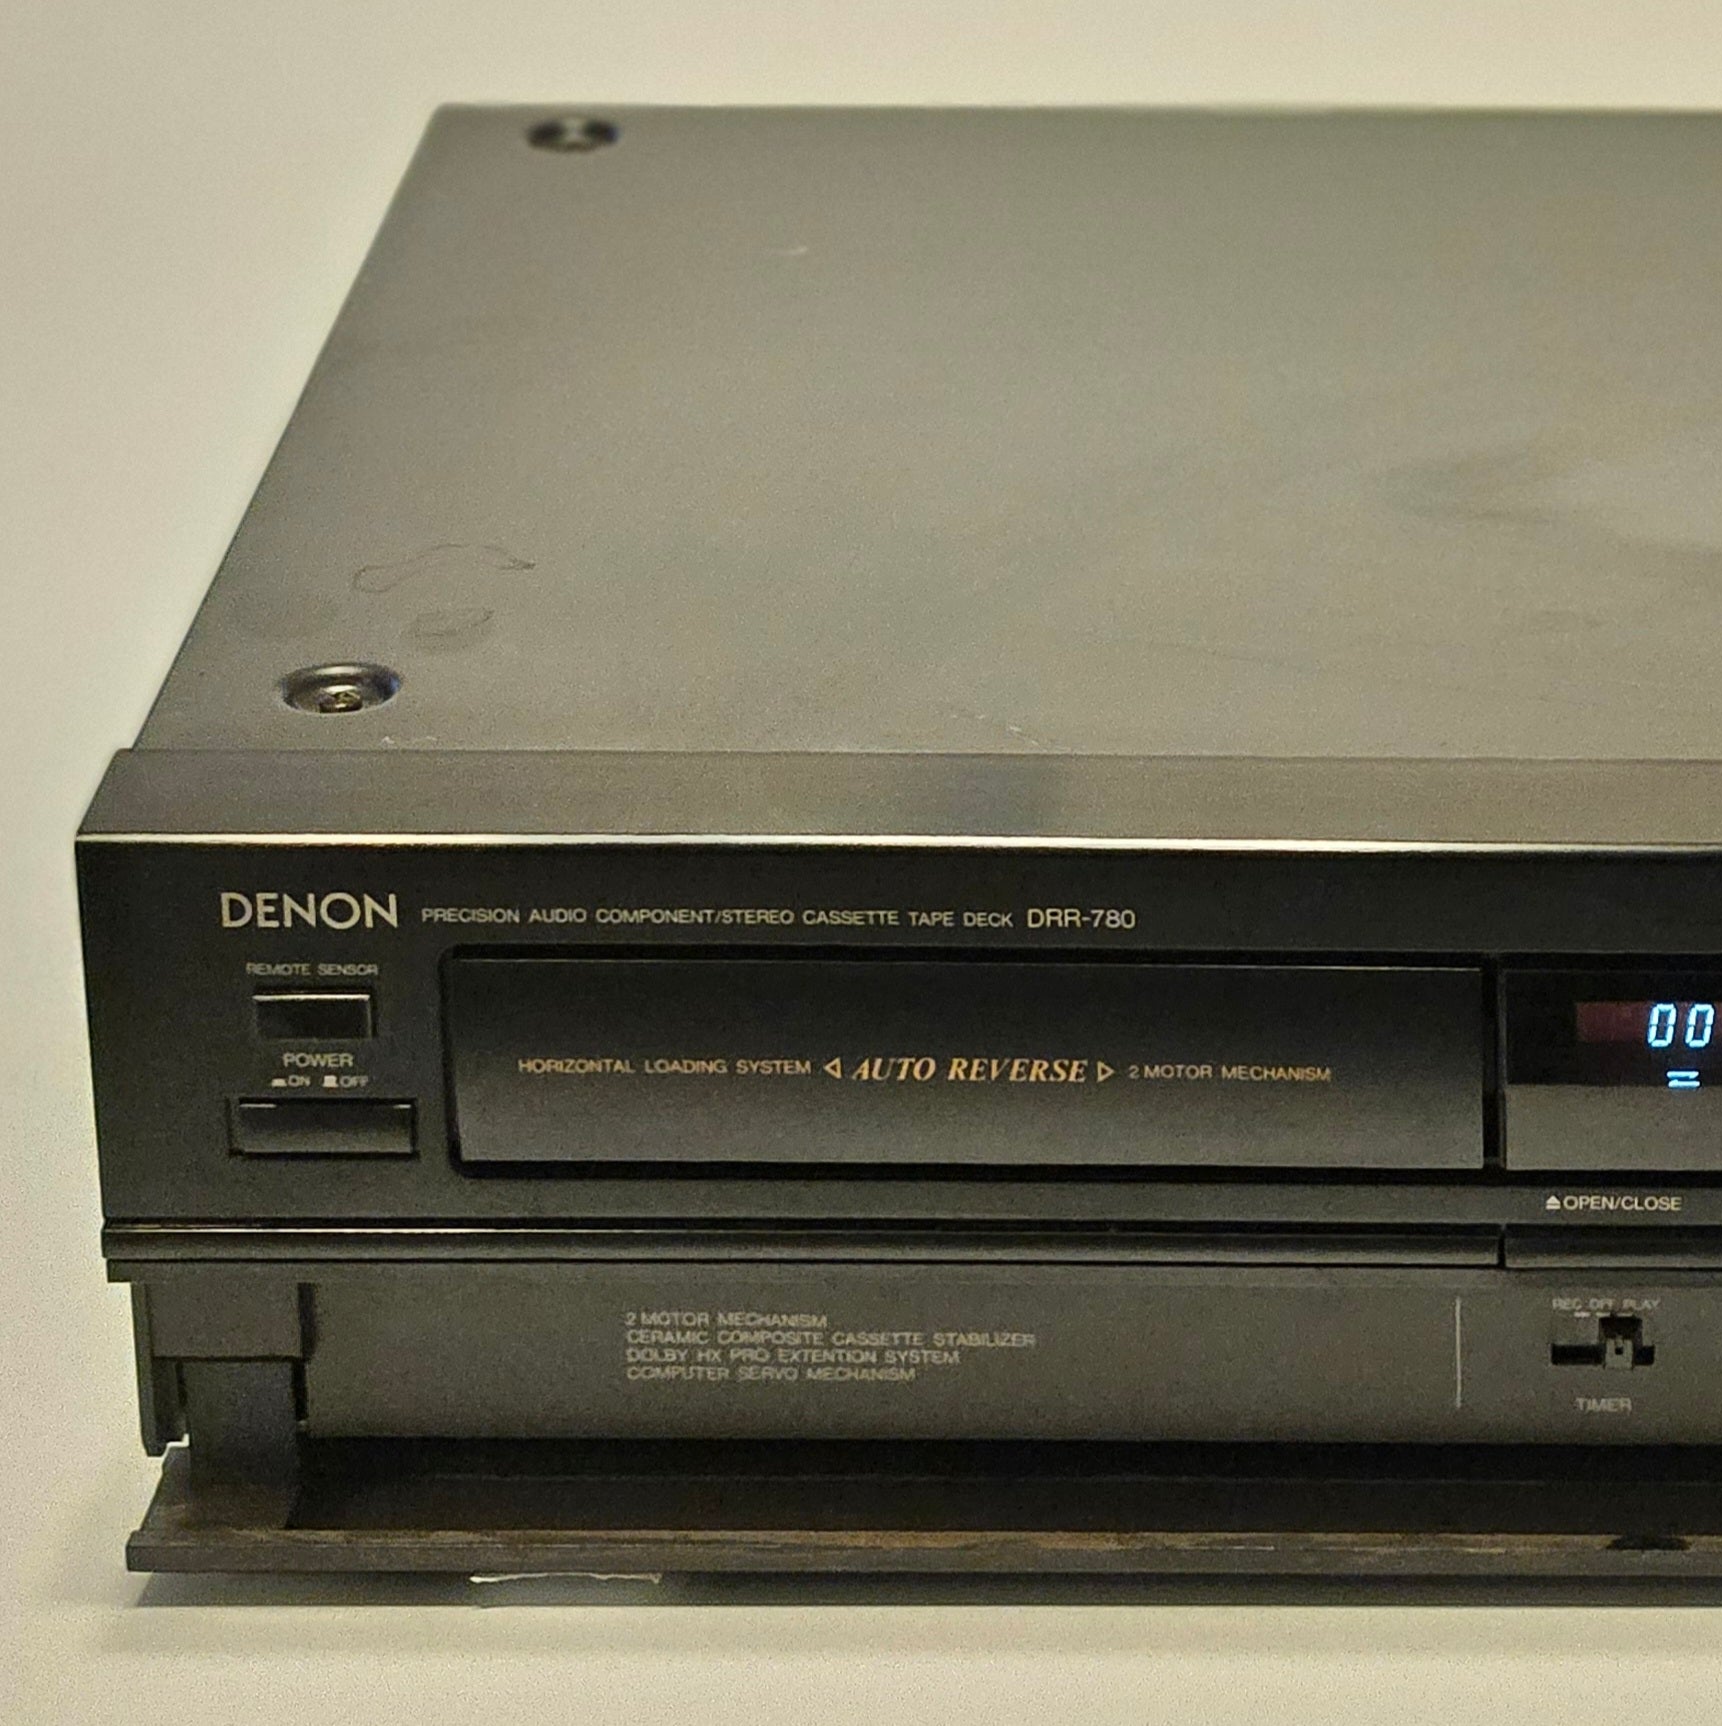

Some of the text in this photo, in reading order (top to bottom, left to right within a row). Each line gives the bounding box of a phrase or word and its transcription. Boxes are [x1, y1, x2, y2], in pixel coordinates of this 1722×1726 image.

[220, 892, 398, 929] DENON
[421, 907, 1137, 929] PRECISION AUDIO COMPONENT/STEREO CASSETTE TAPE DECK DRR-780
[246, 963, 379, 976] REMOTE SENSOR
[283, 1052, 354, 1068] POWER
[518, 1056, 1332, 1084] HORIZONTAL LOADING SYSTEM AUTO REVERSE 2 MOTOR MECHANISM
[288, 1075, 311, 1087] ON
[339, 1075, 369, 1088] OFF
[1563, 1196, 1682, 1211] OPEN/CLOSE
[1551, 1299, 1582, 1310] REC
[1622, 1299, 1660, 1310] PLAY
[625, 1312, 828, 1328] 2 MOTOR MECHANISM
[627, 1330, 1036, 1347] CERAMIC COMPOSITE CASSETTE STABILIZER
[627, 1348, 960, 1364] DOLBY HX PRO EXTENTION SYSTEM
[627, 1366, 916, 1381] COMPUTER SERVO MECHANISM
[1576, 1398, 1632, 1413] TIMER
